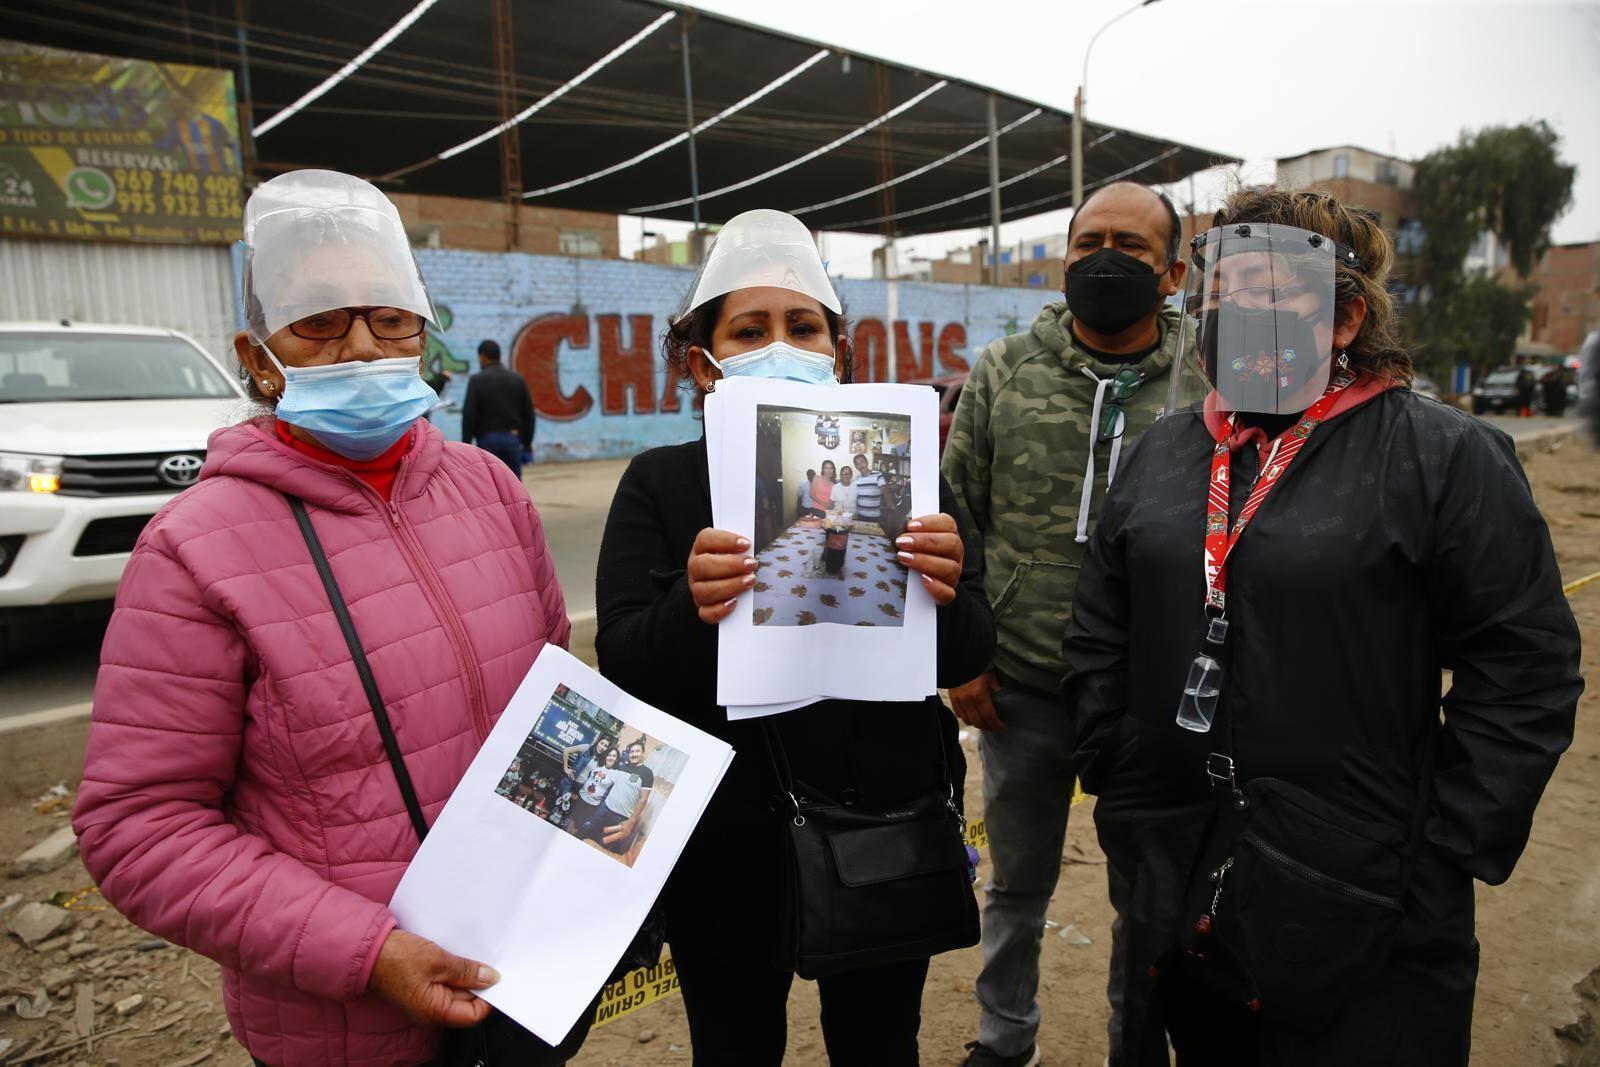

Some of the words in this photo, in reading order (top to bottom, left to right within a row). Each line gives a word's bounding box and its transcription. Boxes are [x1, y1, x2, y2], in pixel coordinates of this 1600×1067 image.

[5, 178, 34, 195] 24
[160, 171, 199, 195] 740
[117, 190, 156, 215] 995
[595, 990, 646, 1022] CRIM
